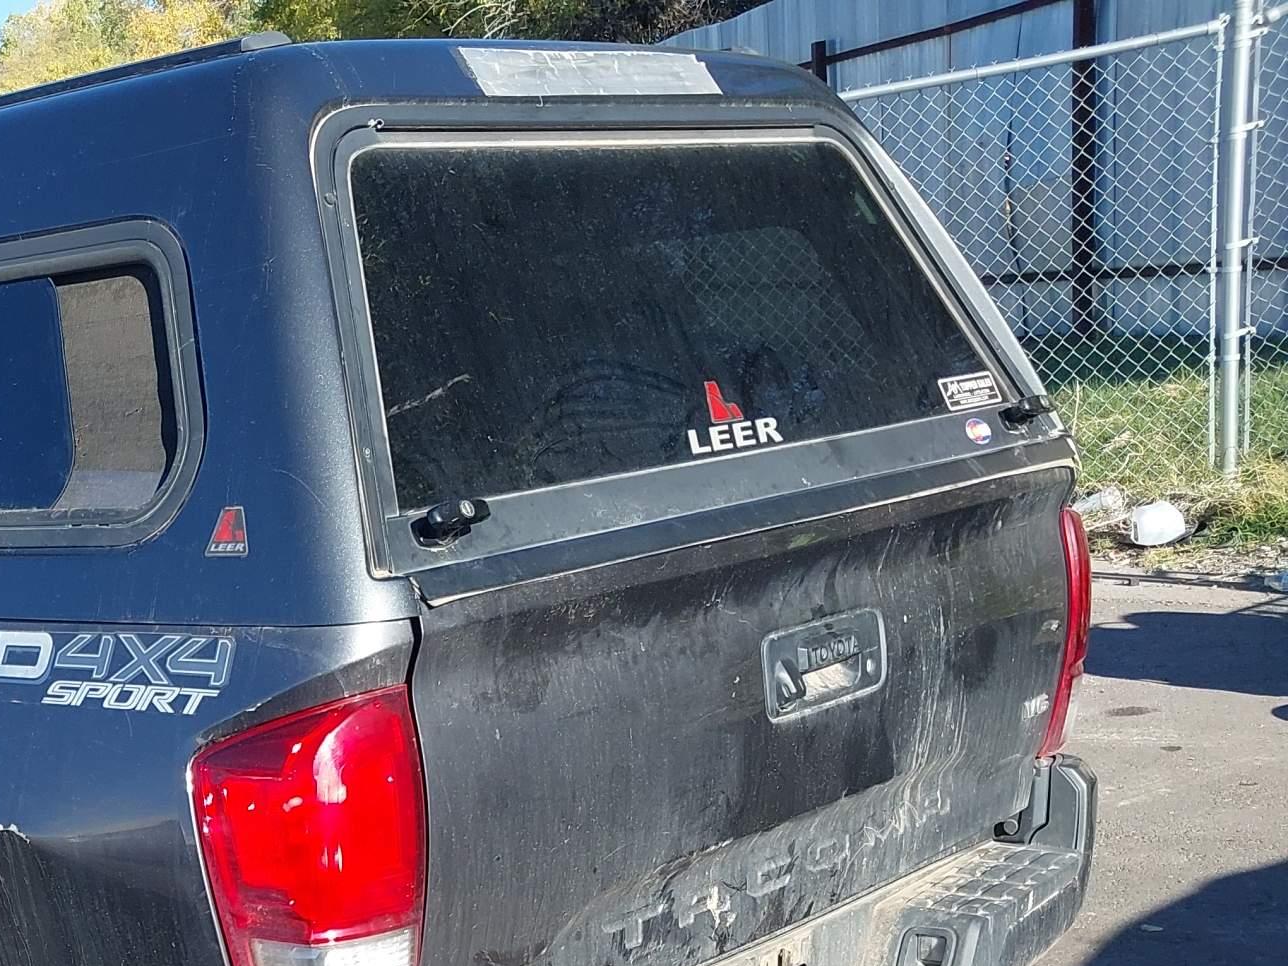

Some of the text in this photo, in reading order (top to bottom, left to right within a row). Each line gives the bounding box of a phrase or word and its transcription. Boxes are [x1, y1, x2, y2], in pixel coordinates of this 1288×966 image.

[687, 417, 784, 455] LEER
[210, 543, 245, 552] LEER
[809, 634, 861, 668] TOYOTA
[40, 680, 221, 716] SPORT
